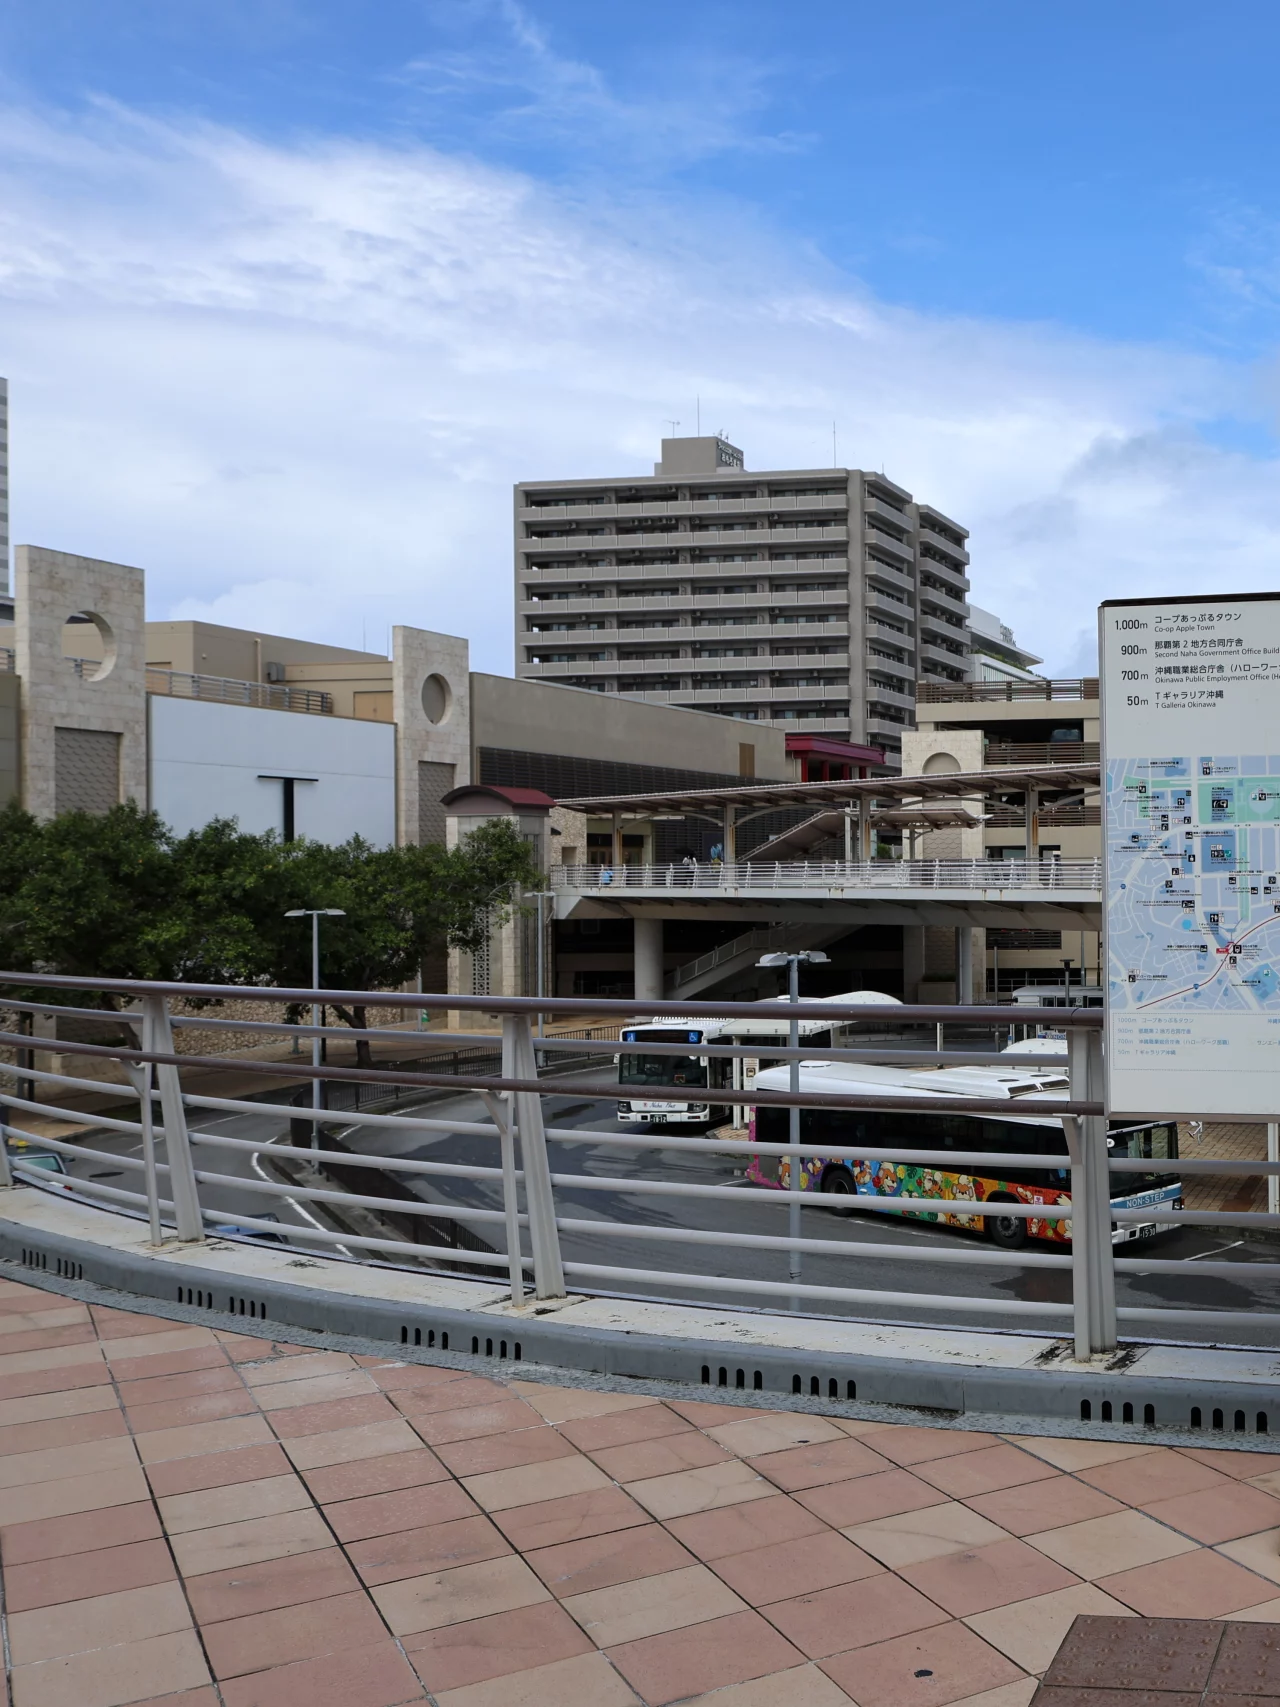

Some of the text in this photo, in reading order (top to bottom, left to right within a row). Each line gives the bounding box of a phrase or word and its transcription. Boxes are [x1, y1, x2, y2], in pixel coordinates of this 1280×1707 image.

[1155, 612, 1242, 624] コープあっぷるタウン
[1115, 619, 1148, 631] 1,000m
[1154, 624, 1174, 633] Co-op
[1176, 624, 1196, 633] Apple
[1121, 645, 1148, 656] 900m
[1199, 649, 1240, 657] Government
[1242, 648, 1262, 656] Office
[1186, 675, 1205, 683] Public
[1206, 674, 1248, 683] Employment
[1250, 673, 1270, 681] Office
[1127, 696, 1149, 706] 50m
[1126, 1192, 1165, 1208] NON-STEP
